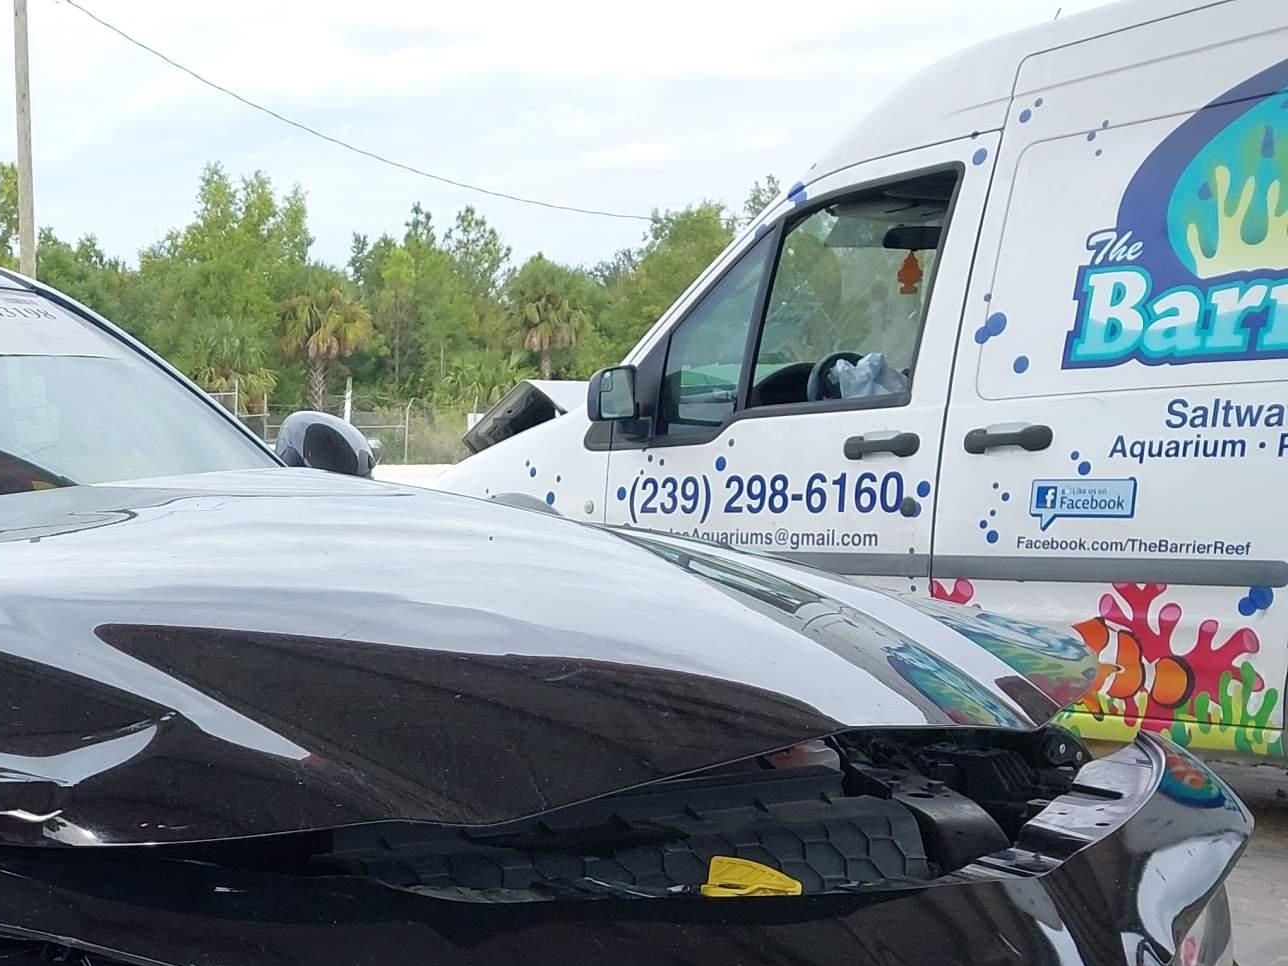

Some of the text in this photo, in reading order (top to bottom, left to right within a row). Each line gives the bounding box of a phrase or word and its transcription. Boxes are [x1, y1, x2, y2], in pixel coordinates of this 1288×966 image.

[1088, 230, 1144, 265] The
[1108, 434, 1247, 465] Aquarium
[629, 471, 904, 523] (239) 298-6160
[1060, 495, 1125, 510] Facebook
[1072, 487, 1087, 495] Like
[1016, 536, 1252, 556] Facebook.com/TheBarrierReef
